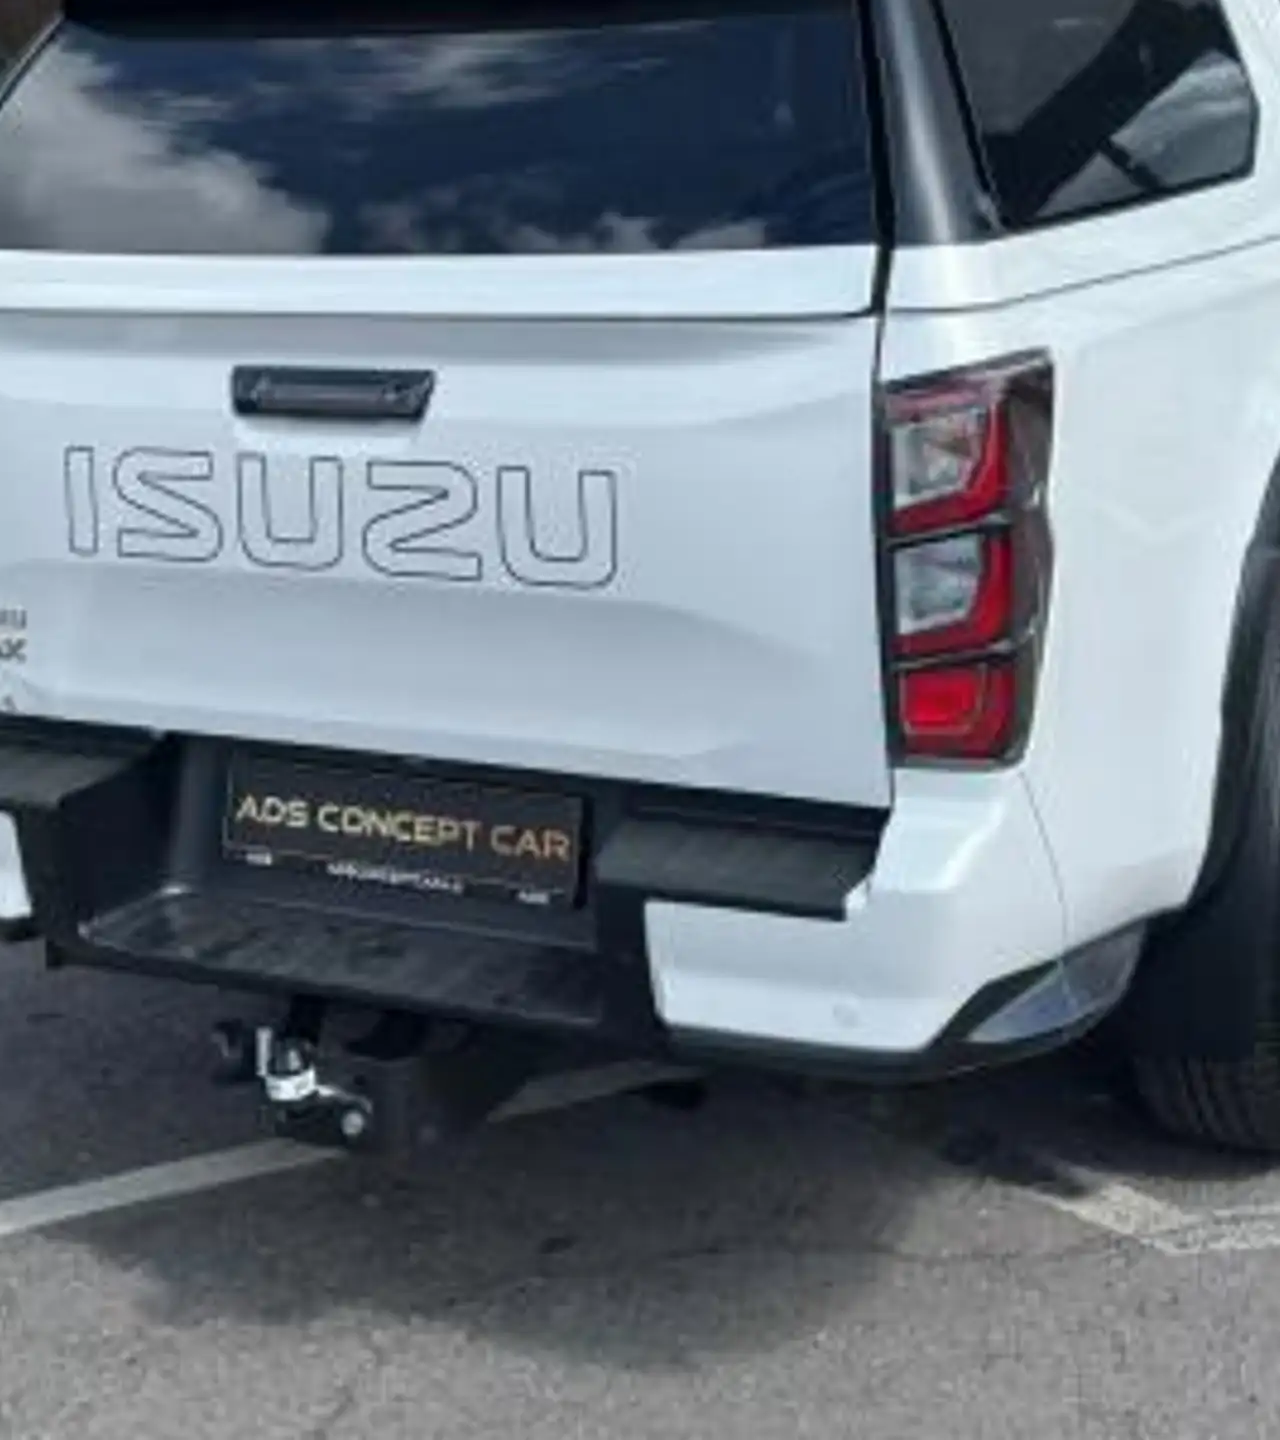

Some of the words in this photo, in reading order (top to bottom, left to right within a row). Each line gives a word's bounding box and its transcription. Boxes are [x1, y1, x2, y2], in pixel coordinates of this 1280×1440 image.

[63, 446, 618, 589] ISUZU
[235, 794, 308, 827] ADS
[318, 805, 482, 853] CONCEPT
[490, 824, 571, 861] CAR
